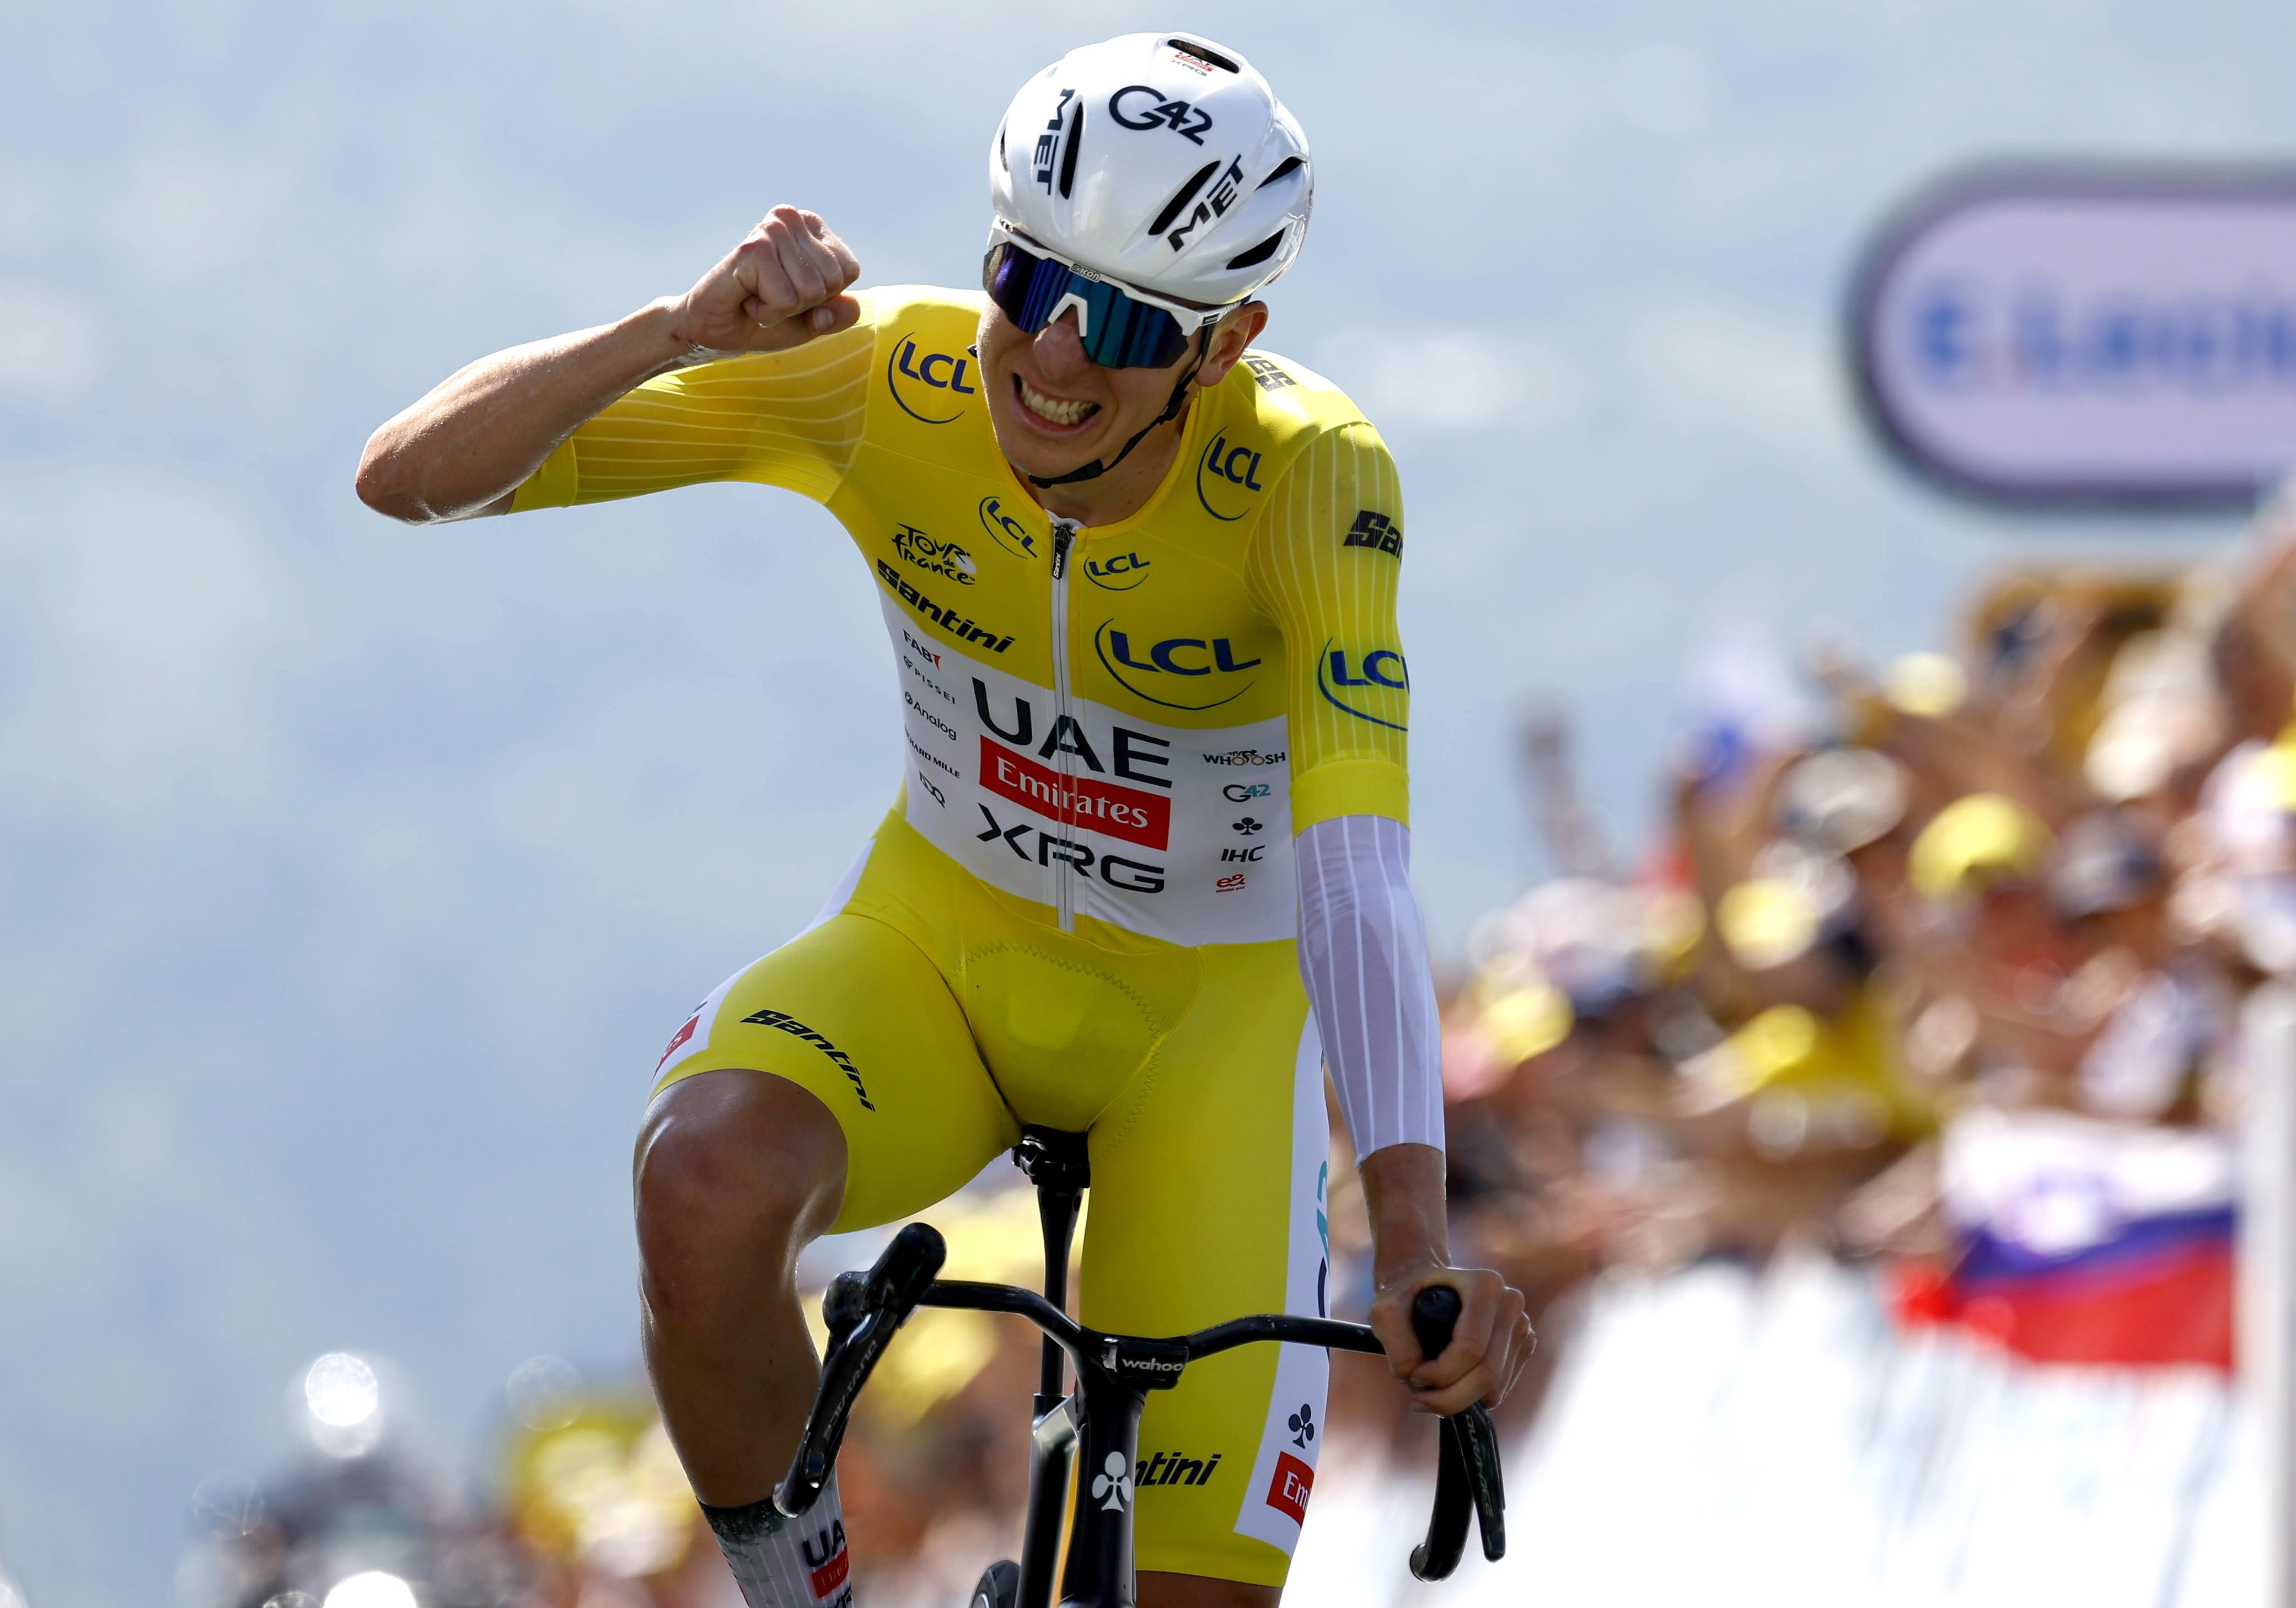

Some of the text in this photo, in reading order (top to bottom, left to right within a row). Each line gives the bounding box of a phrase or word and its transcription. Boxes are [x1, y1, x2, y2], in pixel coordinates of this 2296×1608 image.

[1034, 89, 1076, 195] MET
[1109, 85, 1213, 145] G42
[1167, 154, 1244, 251] MET
[899, 341, 975, 395] LCL
[1208, 437, 1262, 491] LCL
[987, 500, 1038, 558] LCL
[1088, 552, 1151, 576] LCL
[877, 558, 1016, 653] Santini
[1109, 629, 1262, 676] LCL
[914, 668, 956, 705] PISSEI
[913, 701, 957, 741] Analog
[972, 676, 1173, 789] UAE
[904, 725, 961, 779] HARD MILLE
[1203, 751, 1286, 766] WHOOSH
[996, 755, 1149, 828] Emirates
[1222, 784, 1271, 803] G42
[976, 802, 1166, 894] XRG
[1221, 845, 1265, 862] IHC
[739, 1009, 876, 1113] Santini
[1122, 1358, 1185, 1372] wahoo
[1134, 1451, 1222, 1488] ntini
